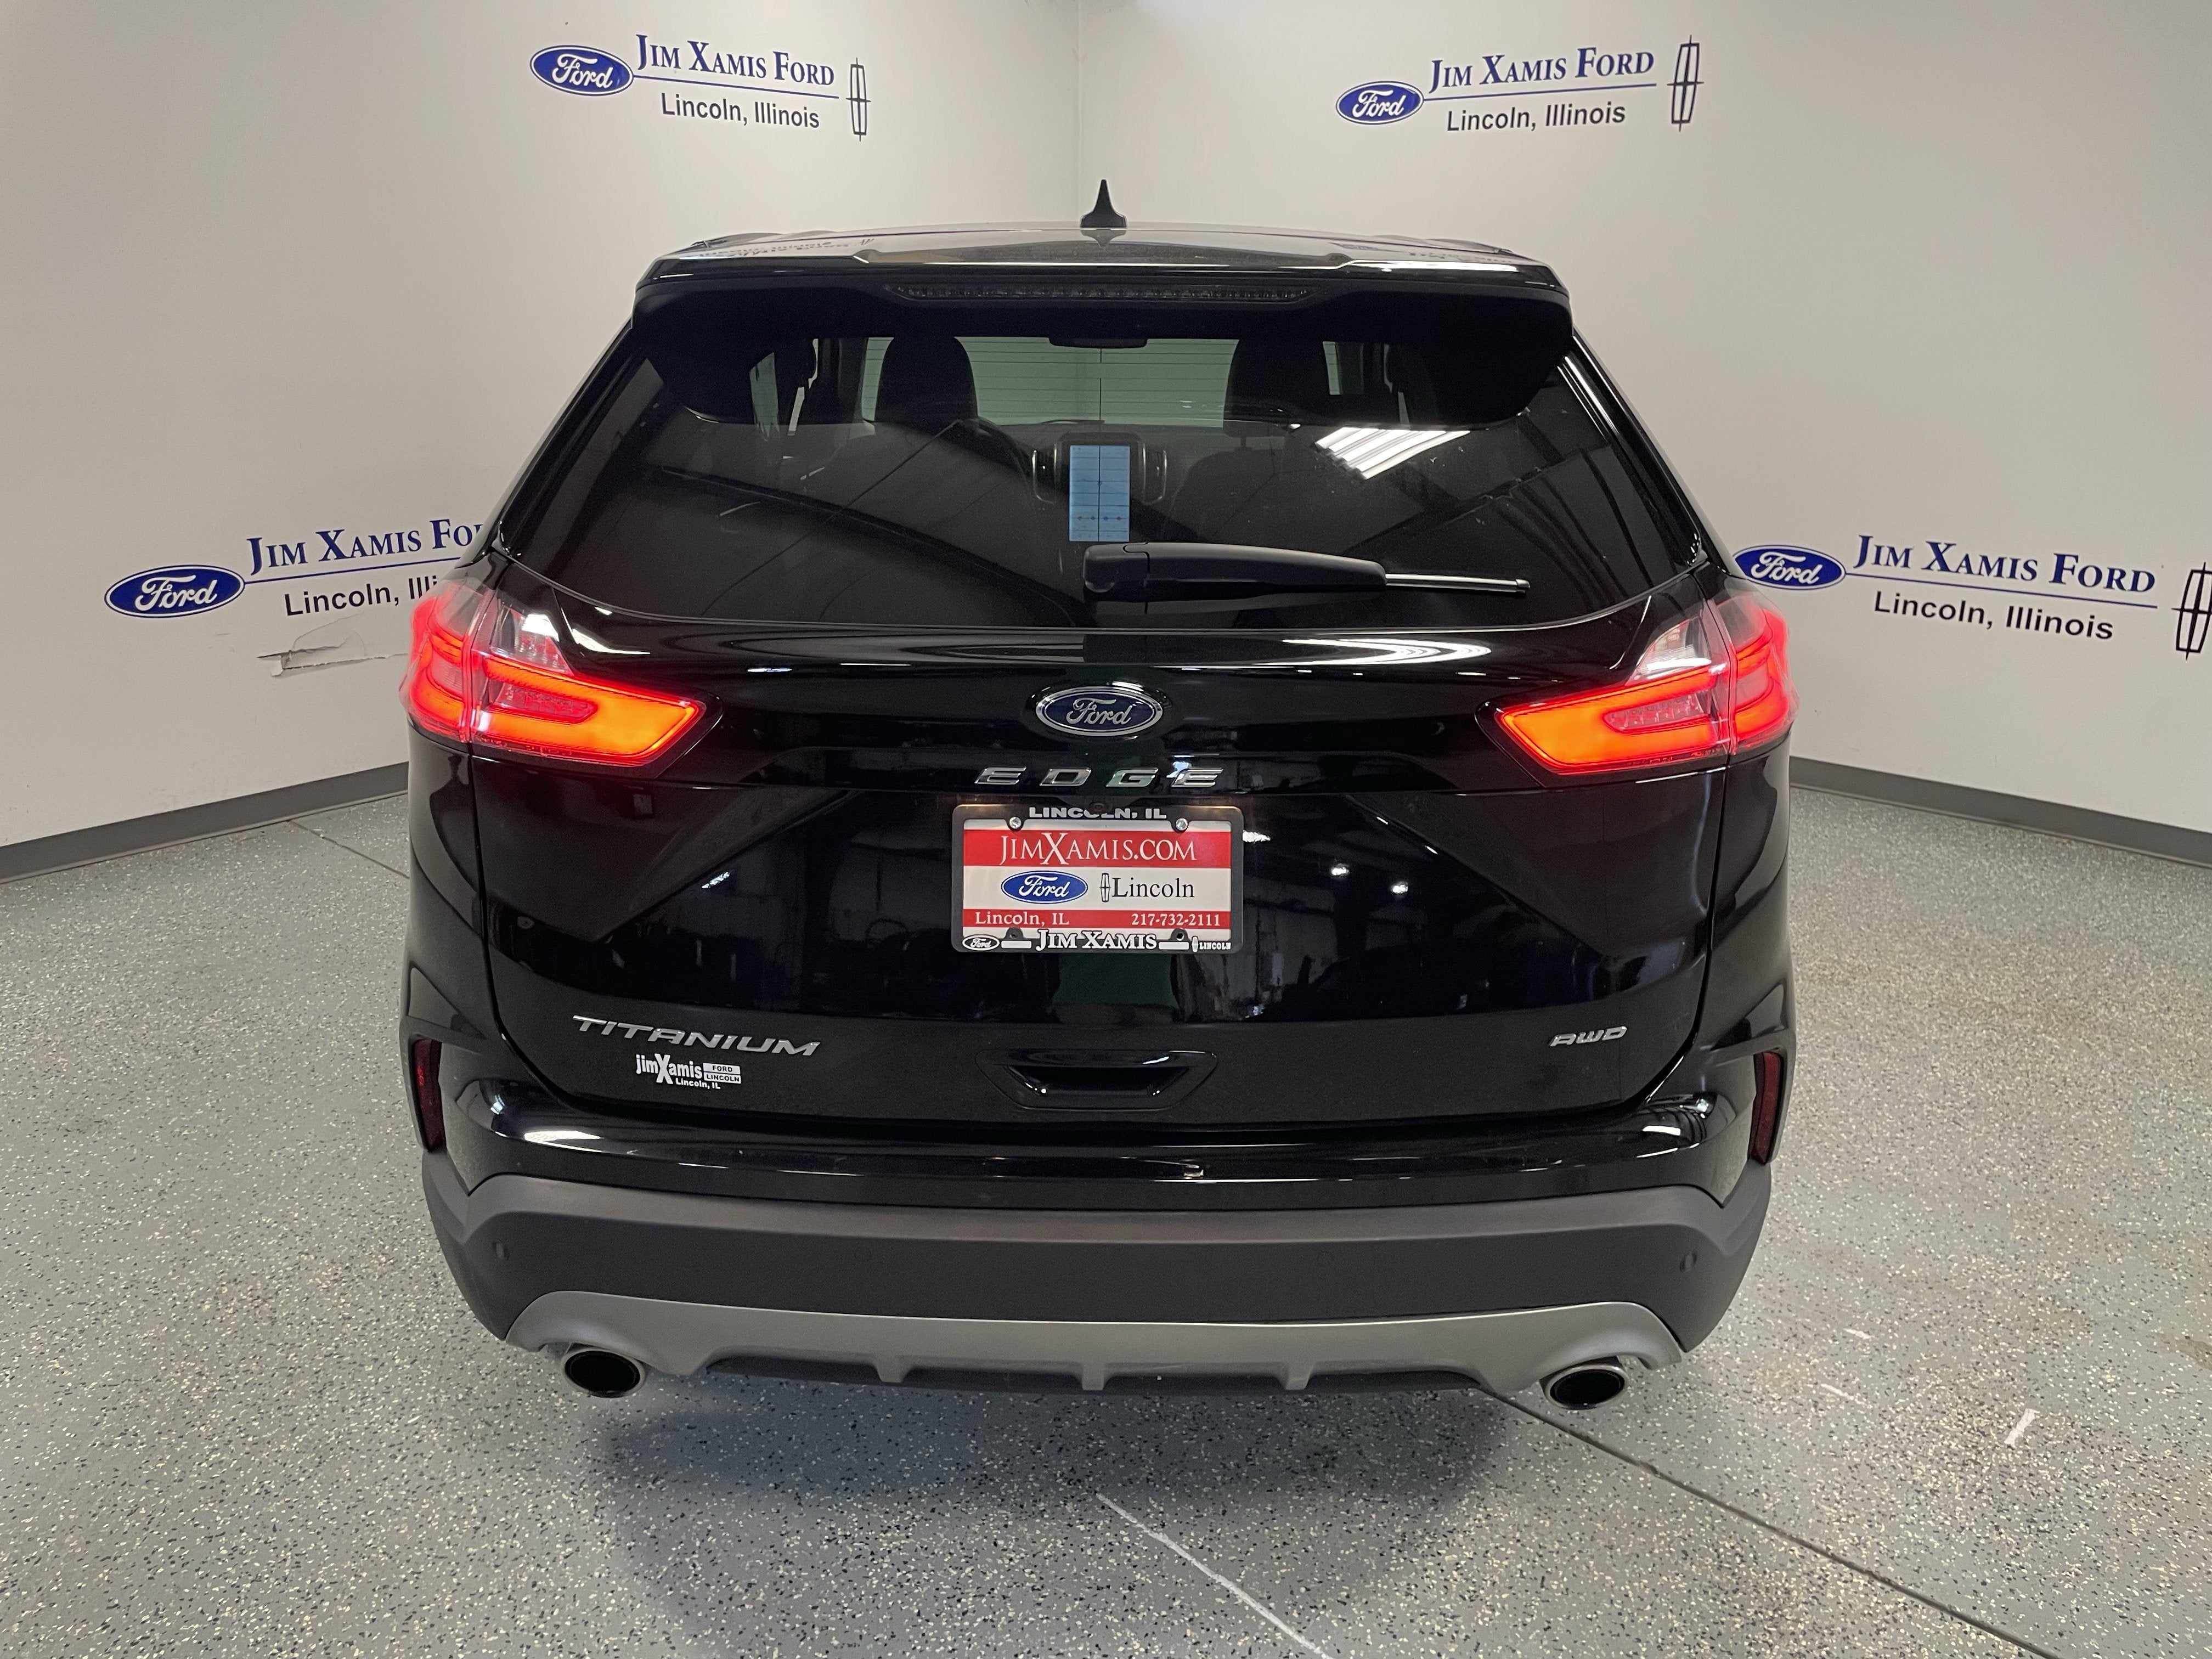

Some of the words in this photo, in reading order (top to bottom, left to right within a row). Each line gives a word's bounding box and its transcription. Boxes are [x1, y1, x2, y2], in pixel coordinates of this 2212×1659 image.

[552, 53, 614, 89] Ford
[636, 35, 681, 70] JIM
[687, 40, 766, 78] XAMIS
[773, 51, 834, 86] FORD
[1429, 59, 1472, 94] JIM
[1479, 55, 1567, 85] XAMIS
[1575, 47, 1654, 78] FORD
[662, 92, 747, 126] Lincoln,
[754, 101, 820, 128] Illinois
[1351, 89, 1407, 119] Ford
[1447, 106, 1536, 132] Lincoln,
[1545, 101, 1626, 126] Illinois
[247, 537, 308, 576] JIM
[315, 529, 422, 562] XAMIS
[430, 518, 483, 550] FO
[1750, 551, 1823, 586] Ford
[1853, 535, 1912, 569] JIM
[1921, 541, 2038, 582] XAMIS
[2049, 553, 2156, 593] FORD
[134, 574, 218, 612] Ford
[284, 583, 399, 617] Lincoln,
[1875, 591, 1993, 630] Lincoln,
[2006, 606, 2114, 640] Illinois
[1065, 697, 1132, 725] Ford
[974, 766, 1224, 788] EDGE
[1145, 808, 1167, 819] IL
[1018, 874, 1070, 899] Ford
[1111, 877, 1195, 898] Lincoln
[975, 911, 1045, 927] Lincoln,
[1052, 912, 1070, 926] IL
[1131, 913, 1221, 927] 217-732-2111
[970, 938, 992, 949] Ford
[1035, 929, 1077, 952] JIM
[1082, 930, 1157, 950] XAMIS
[1199, 942, 1232, 950] LINCOLN
[572, 1015, 821, 1056] TITANIUM
[1549, 1026, 1627, 1047] AWD
[675, 1077, 710, 1090] Lincoln,
[706, 1074, 740, 1082] LINCOLN
